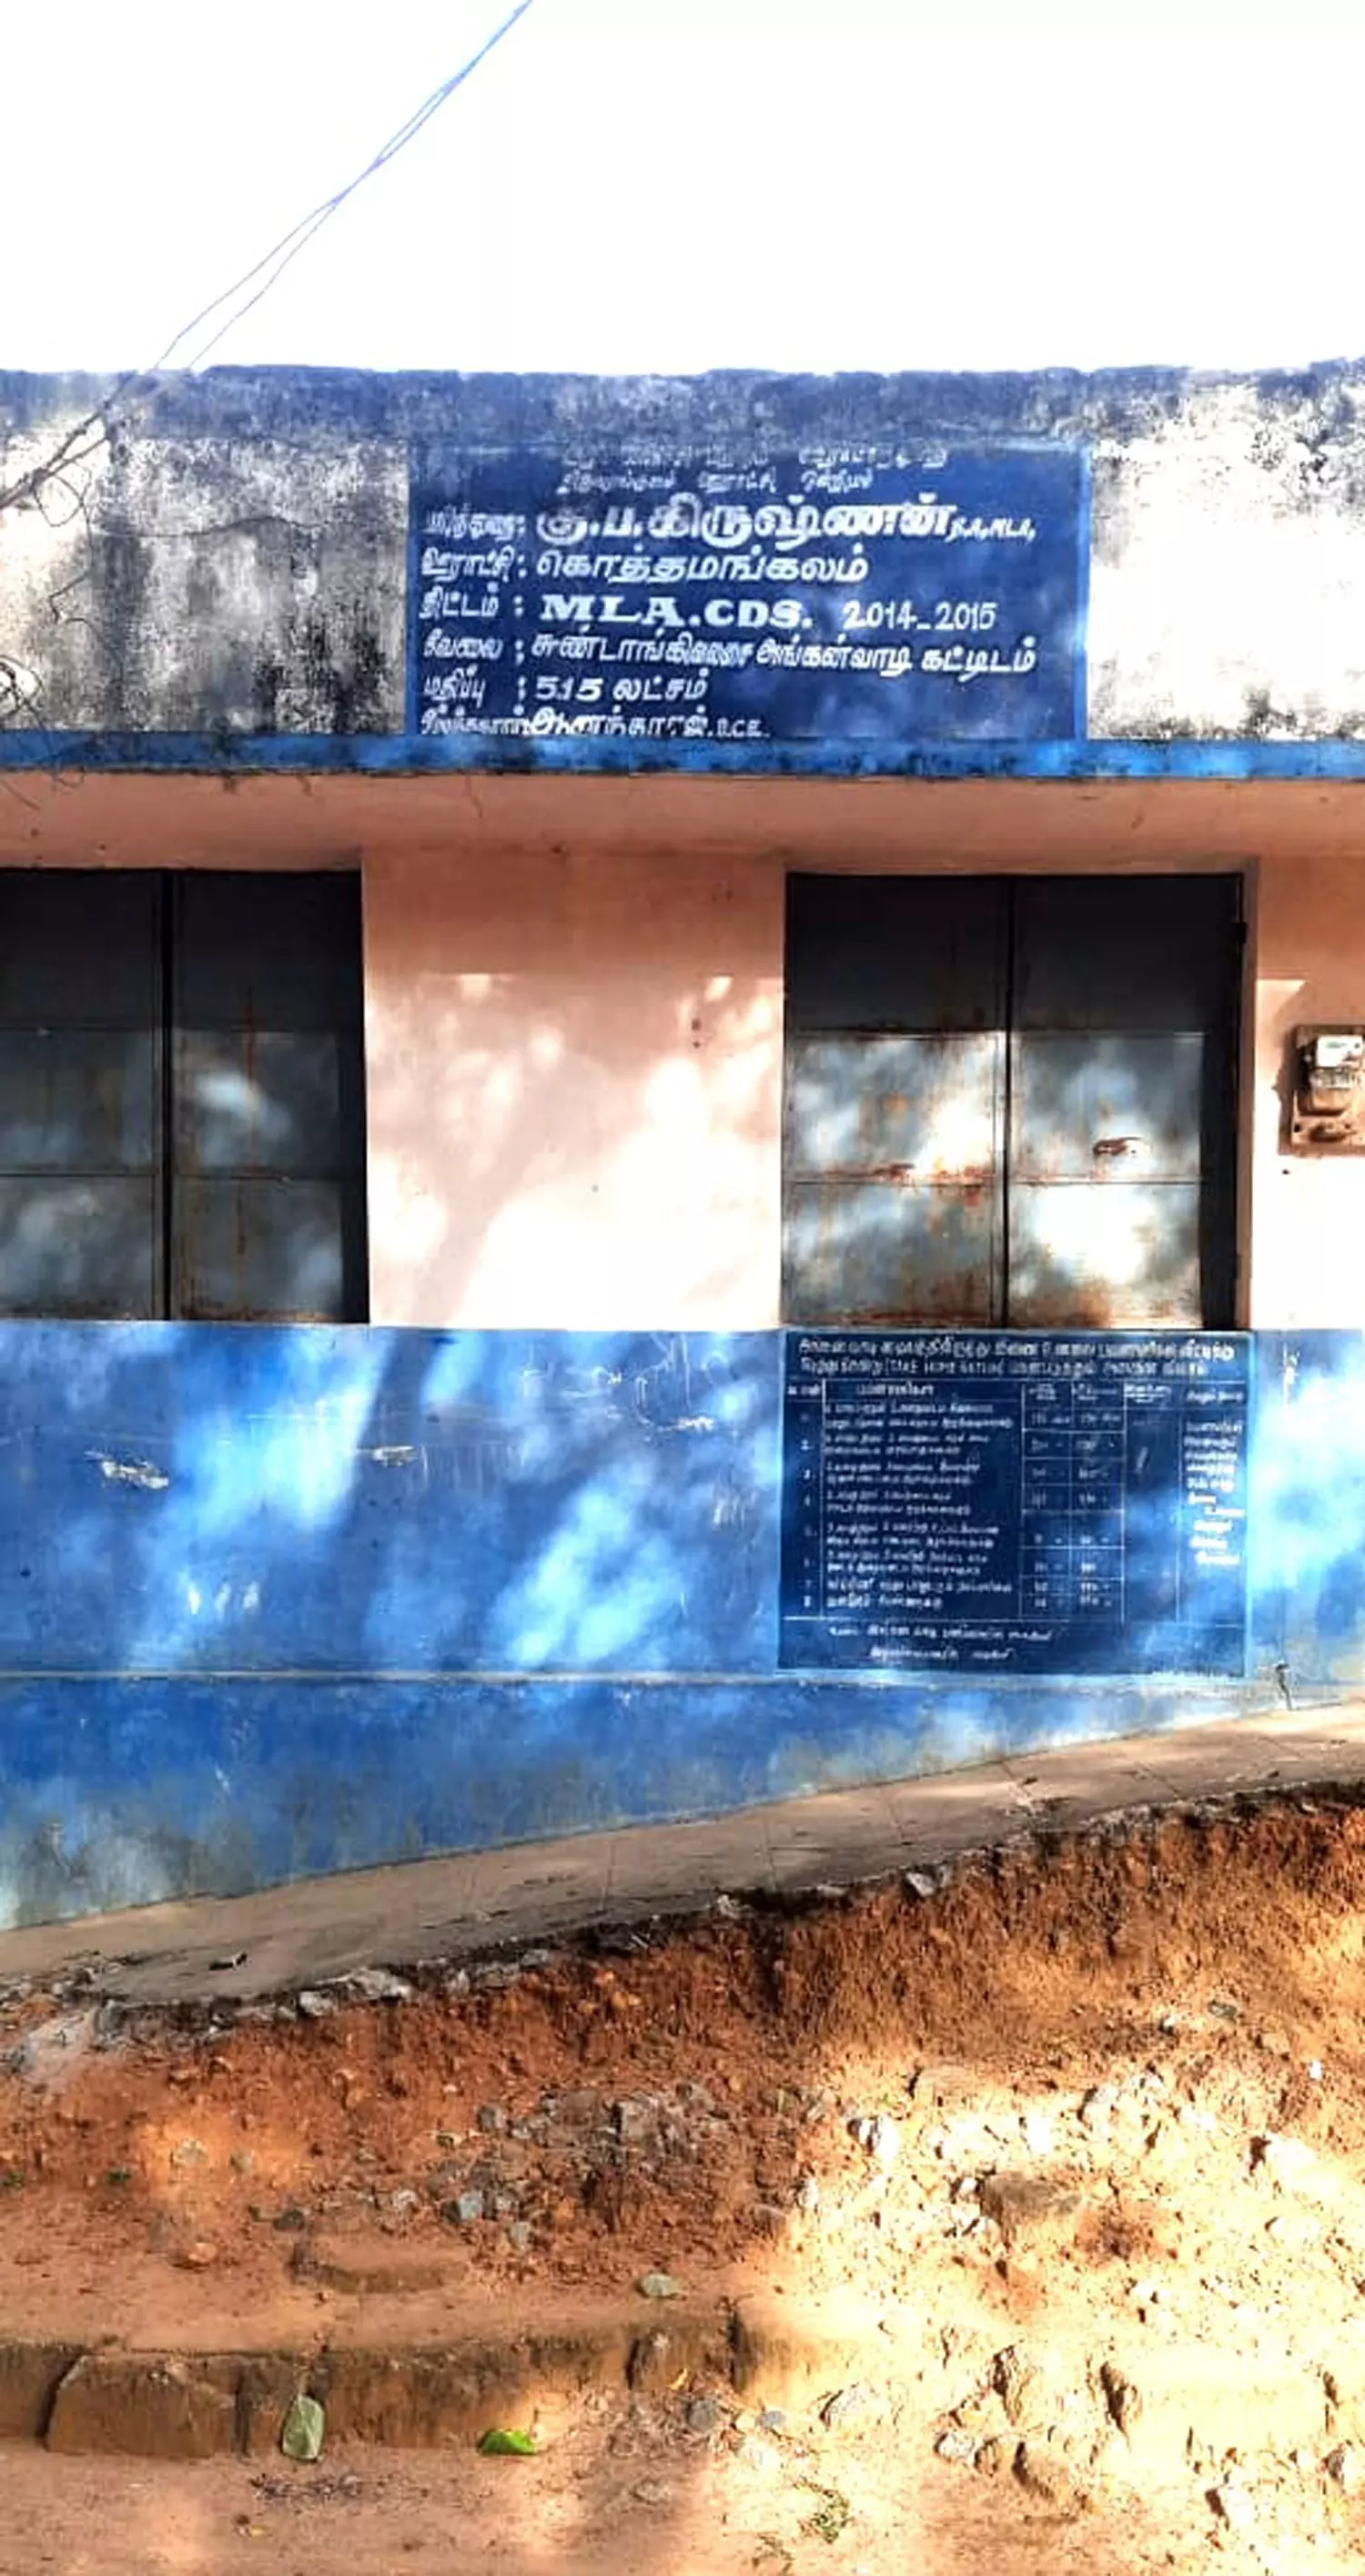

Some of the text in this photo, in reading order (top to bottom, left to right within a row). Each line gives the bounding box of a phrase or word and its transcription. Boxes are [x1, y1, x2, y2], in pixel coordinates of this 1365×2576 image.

[536, 541, 870, 584] கொத்தமங்கலம்
[422, 626, 504, 661] வேலை
[920, 634, 1037, 683] கட்டிடம்
[612, 667, 710, 705] லட்சம்
